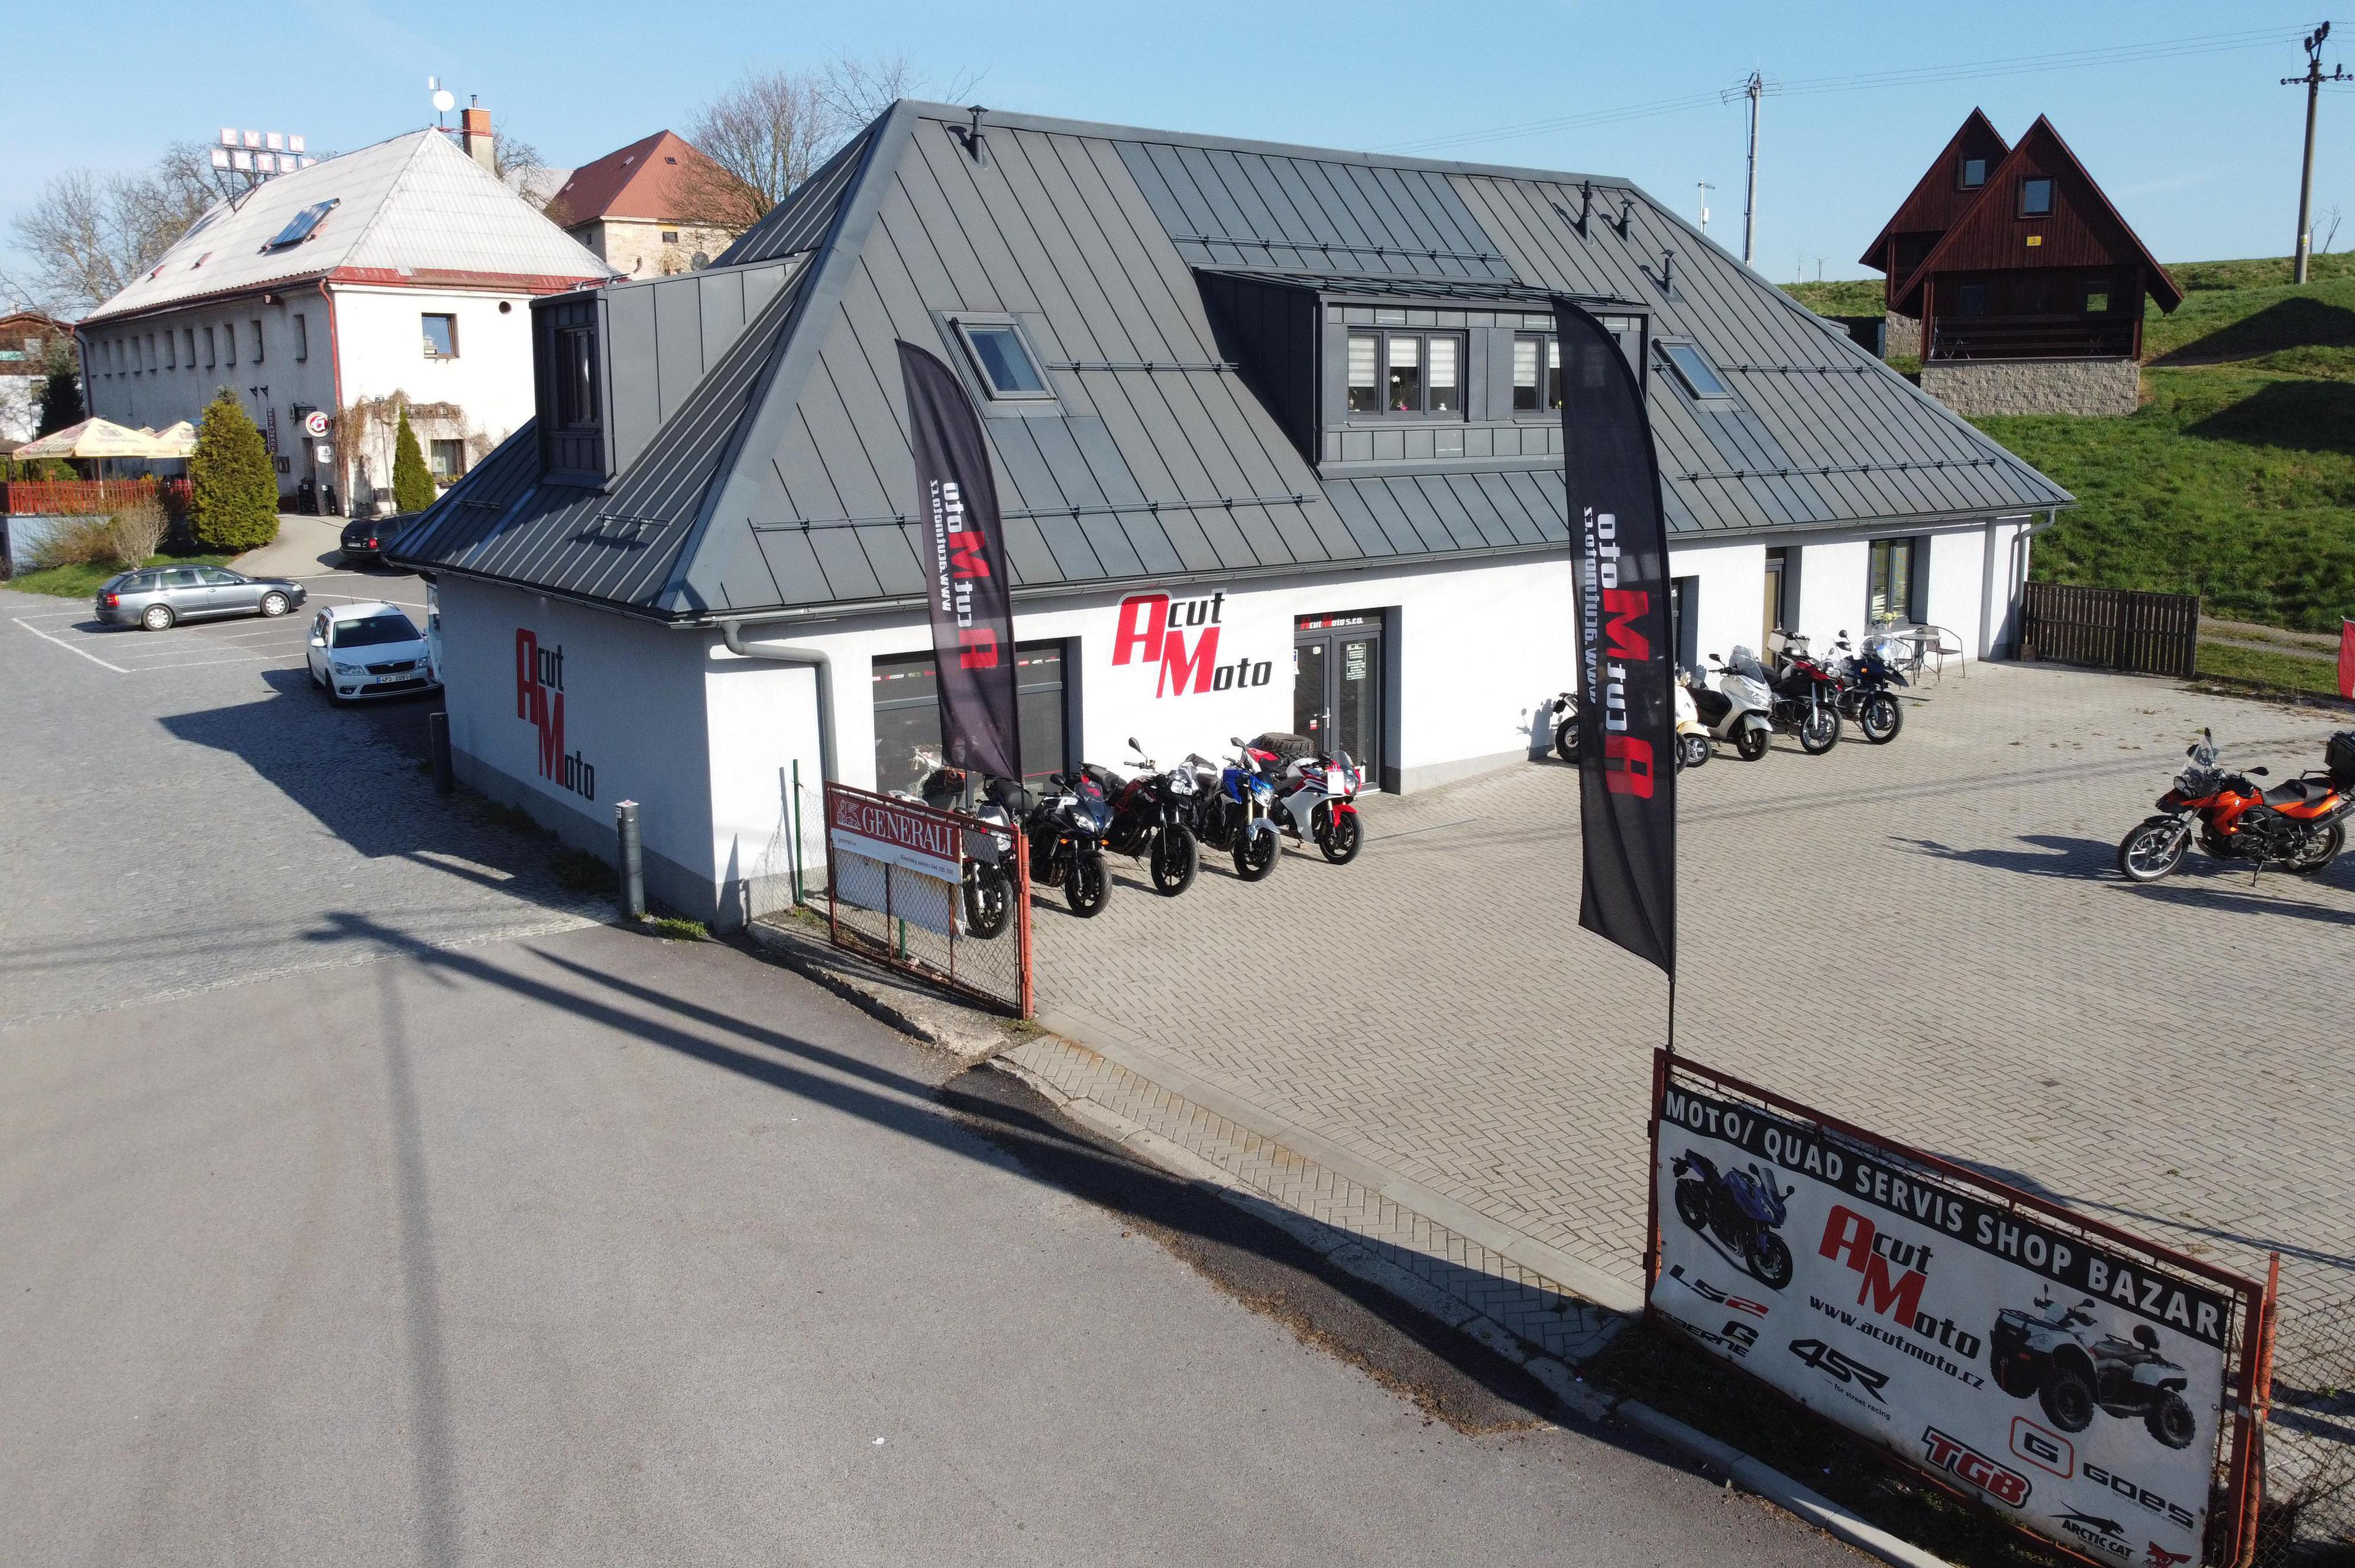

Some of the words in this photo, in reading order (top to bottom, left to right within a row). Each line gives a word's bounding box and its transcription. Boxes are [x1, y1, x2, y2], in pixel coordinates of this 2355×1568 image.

[227, 130, 304, 151] EVEN
[862, 806, 953, 857] GENERALI
[1665, 1090, 1754, 1145] MOTO/
[1764, 1128, 1843, 1181] QUAD
[1855, 1164, 1963, 1233] SERVIS
[1976, 1214, 2071, 1276] SHOP
[2088, 1256, 2219, 1340] BAZAR
[1669, 1264, 1770, 1320] LS2
[1810, 1295, 1985, 1390] www.acutmoto.cz
[1788, 1339, 1891, 1405] 4SR
[1835, 1384, 1845, 1394] for
[1846, 1391, 1866, 1408] street
[1867, 1402, 1891, 1421] racing
[1923, 1427, 2031, 1508] TGB
[2062, 1520, 2107, 1547] ARCTIC
[2108, 1540, 2135, 1558] CAT
